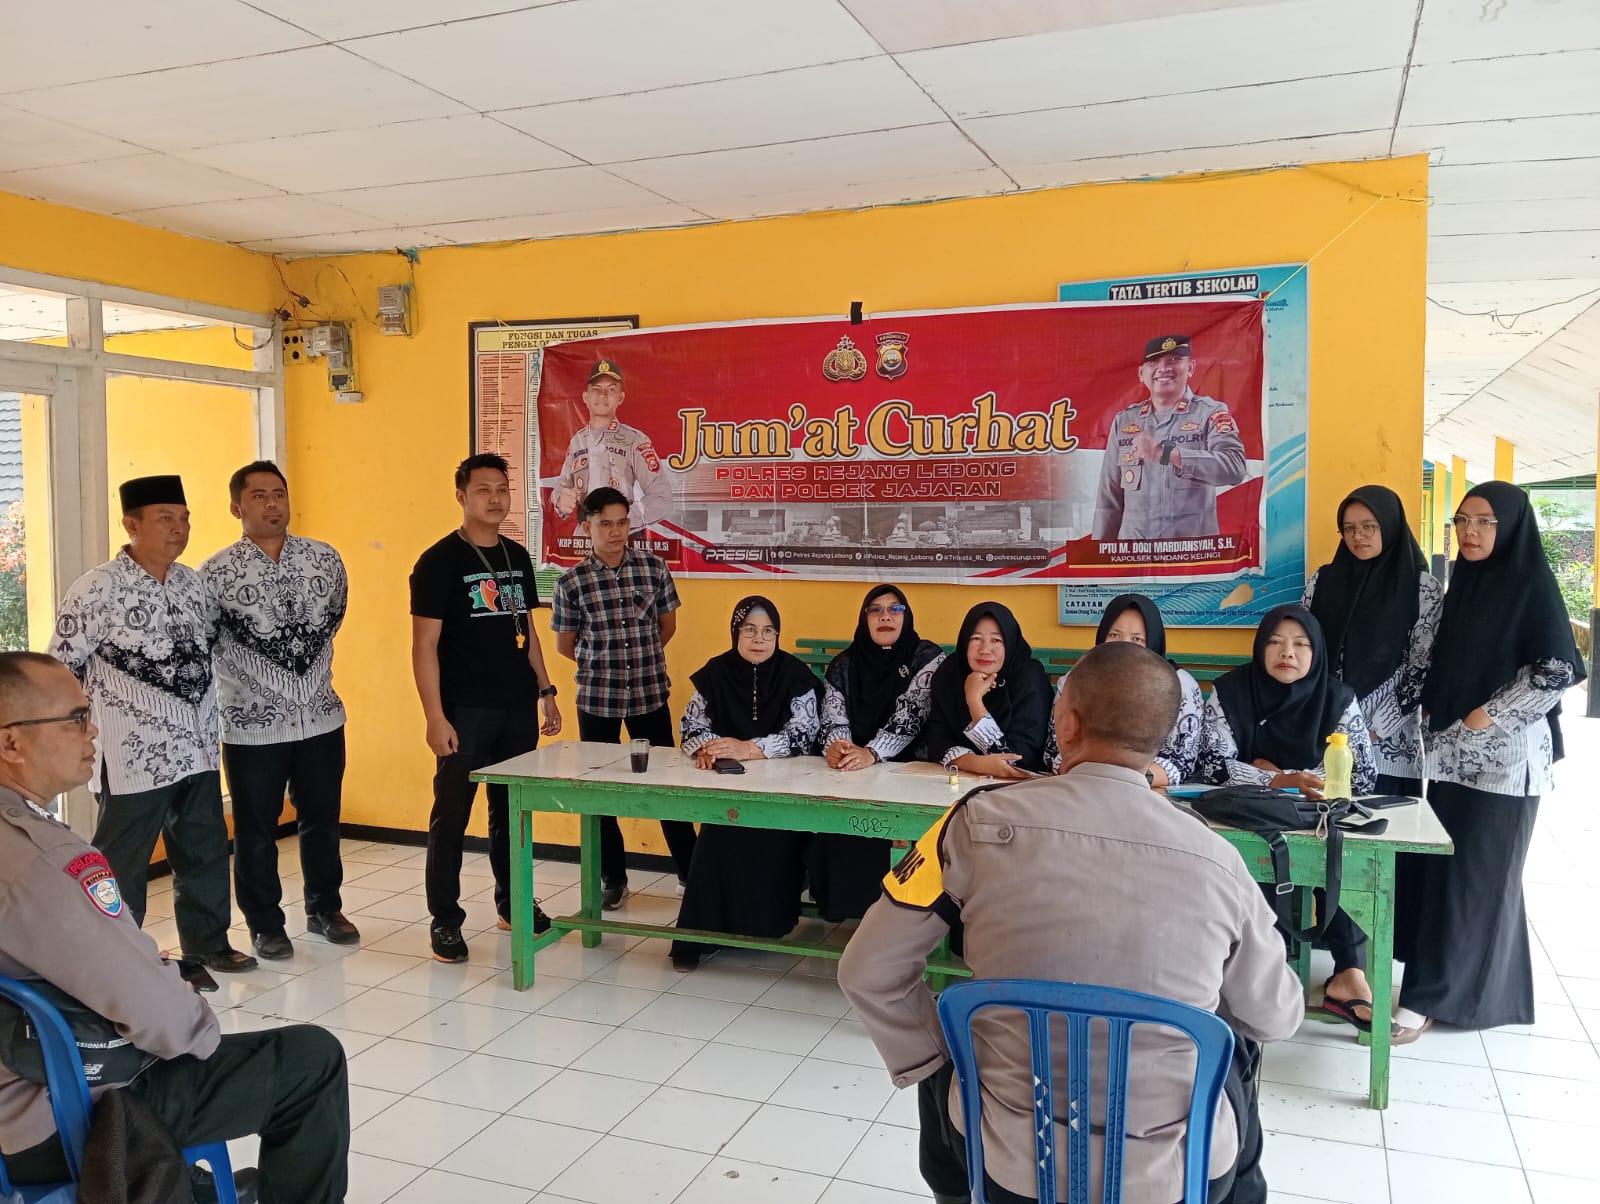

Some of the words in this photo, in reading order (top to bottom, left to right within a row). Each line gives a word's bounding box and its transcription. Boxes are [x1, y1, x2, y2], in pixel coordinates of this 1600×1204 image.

[1110, 286, 1142, 300] TATA
[1145, 283, 1191, 298] TERTIB
[1195, 276, 1257, 294] SEKOLAH
[508, 332, 543, 341] FUNGSI
[545, 331, 564, 339] DAN
[567, 330, 599, 338] TUGAS
[866, 392, 1079, 457] Curhat
[1171, 433, 1205, 443] POLRI
[715, 466, 807, 481] POLRES
[813, 465, 910, 481] REJANG
[917, 462, 1017, 479] LEBONG
[731, 484, 775, 499] DAN
[782, 483, 876, 499] POLSEK
[881, 481, 1001, 498] JAJARAN
[1099, 542, 1117, 554] IPTU
[1118, 542, 1131, 553] M.
[1132, 541, 1152, 553] DODI
[1153, 539, 1217, 552] MARDIANSYAH,
[1217, 538, 1236, 549] S.H.
[705, 549, 763, 561] PRESISI
[1111, 554, 1152, 562] KAPOLSEK
[1153, 553, 1189, 562] SINDANG
[1190, 552, 1221, 560] KELINGI
